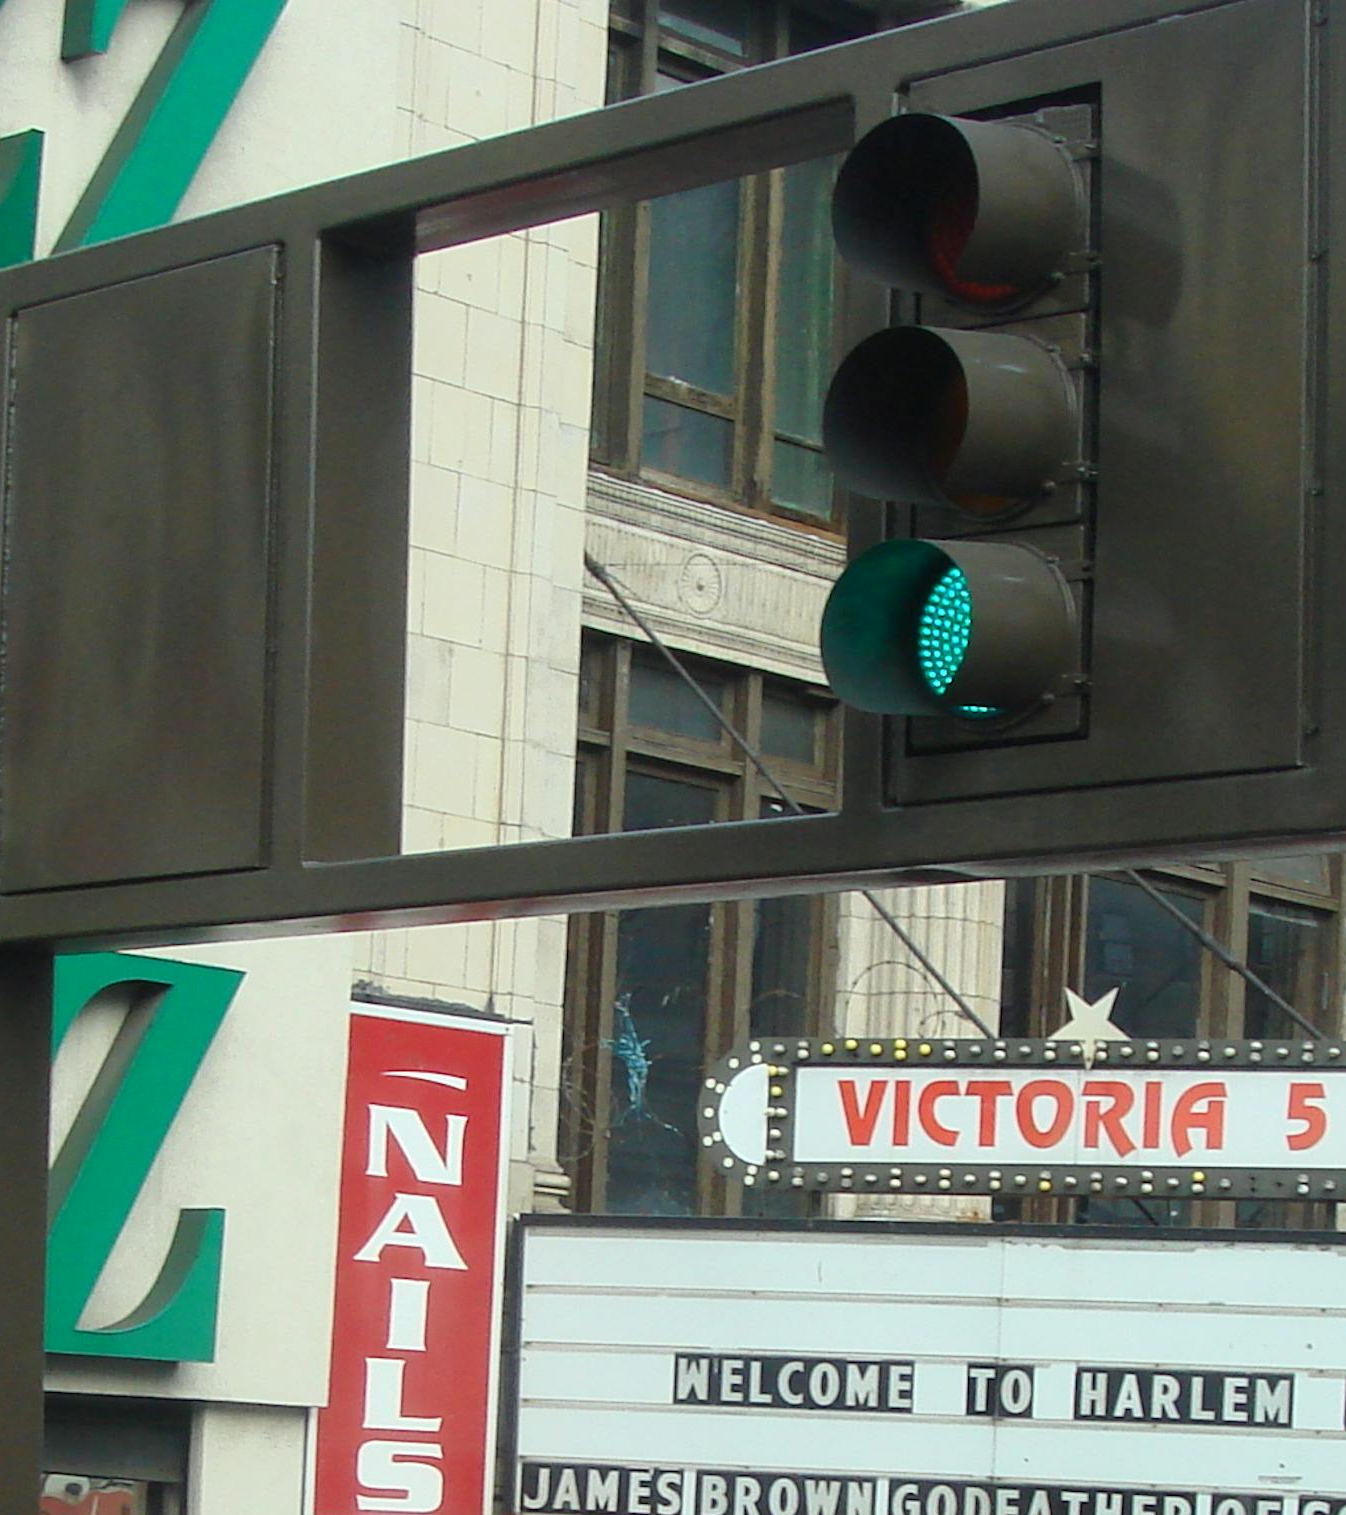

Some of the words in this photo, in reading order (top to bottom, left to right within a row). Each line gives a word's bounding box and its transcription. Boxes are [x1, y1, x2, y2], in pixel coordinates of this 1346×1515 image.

[839, 1077, 1228, 1159] VICTORIA
[1285, 1081, 1328, 1153] 5
[675, 1356, 914, 1409] WELCOME
[968, 1368, 1033, 1416] TO
[1079, 1371, 1293, 1425] HARLEM
